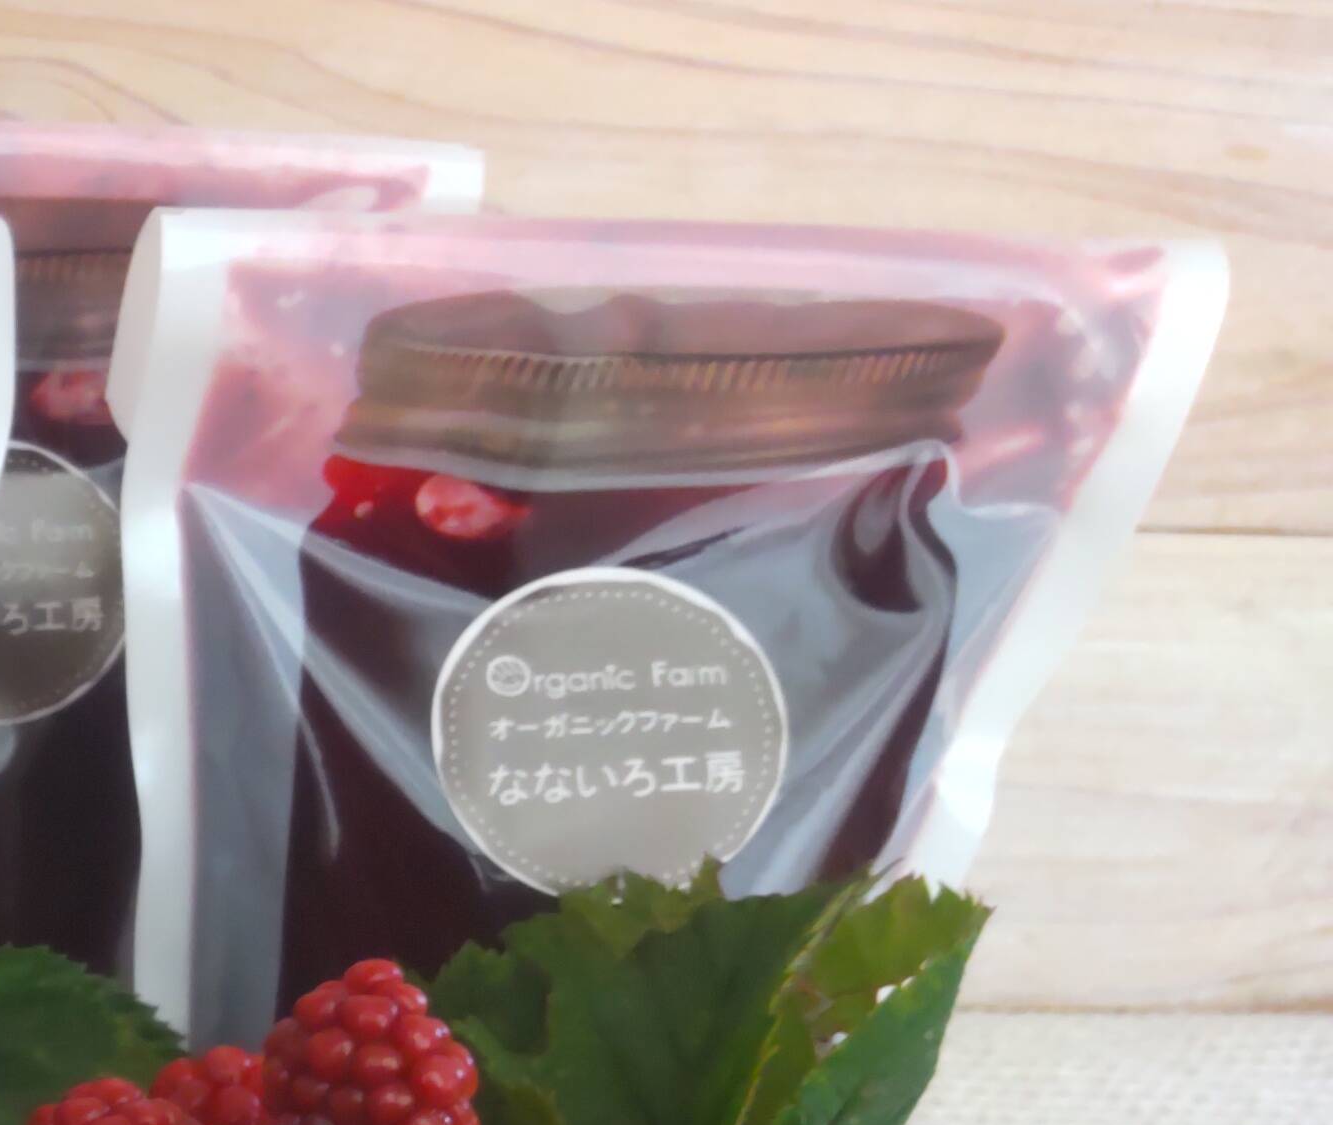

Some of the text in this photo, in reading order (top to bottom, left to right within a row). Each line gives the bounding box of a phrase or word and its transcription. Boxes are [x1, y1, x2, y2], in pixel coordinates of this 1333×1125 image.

[486, 655, 728, 699] Organic Farm
[488, 708, 731, 741] オーガニックファーム
[487, 750, 746, 806] なないろ工房
